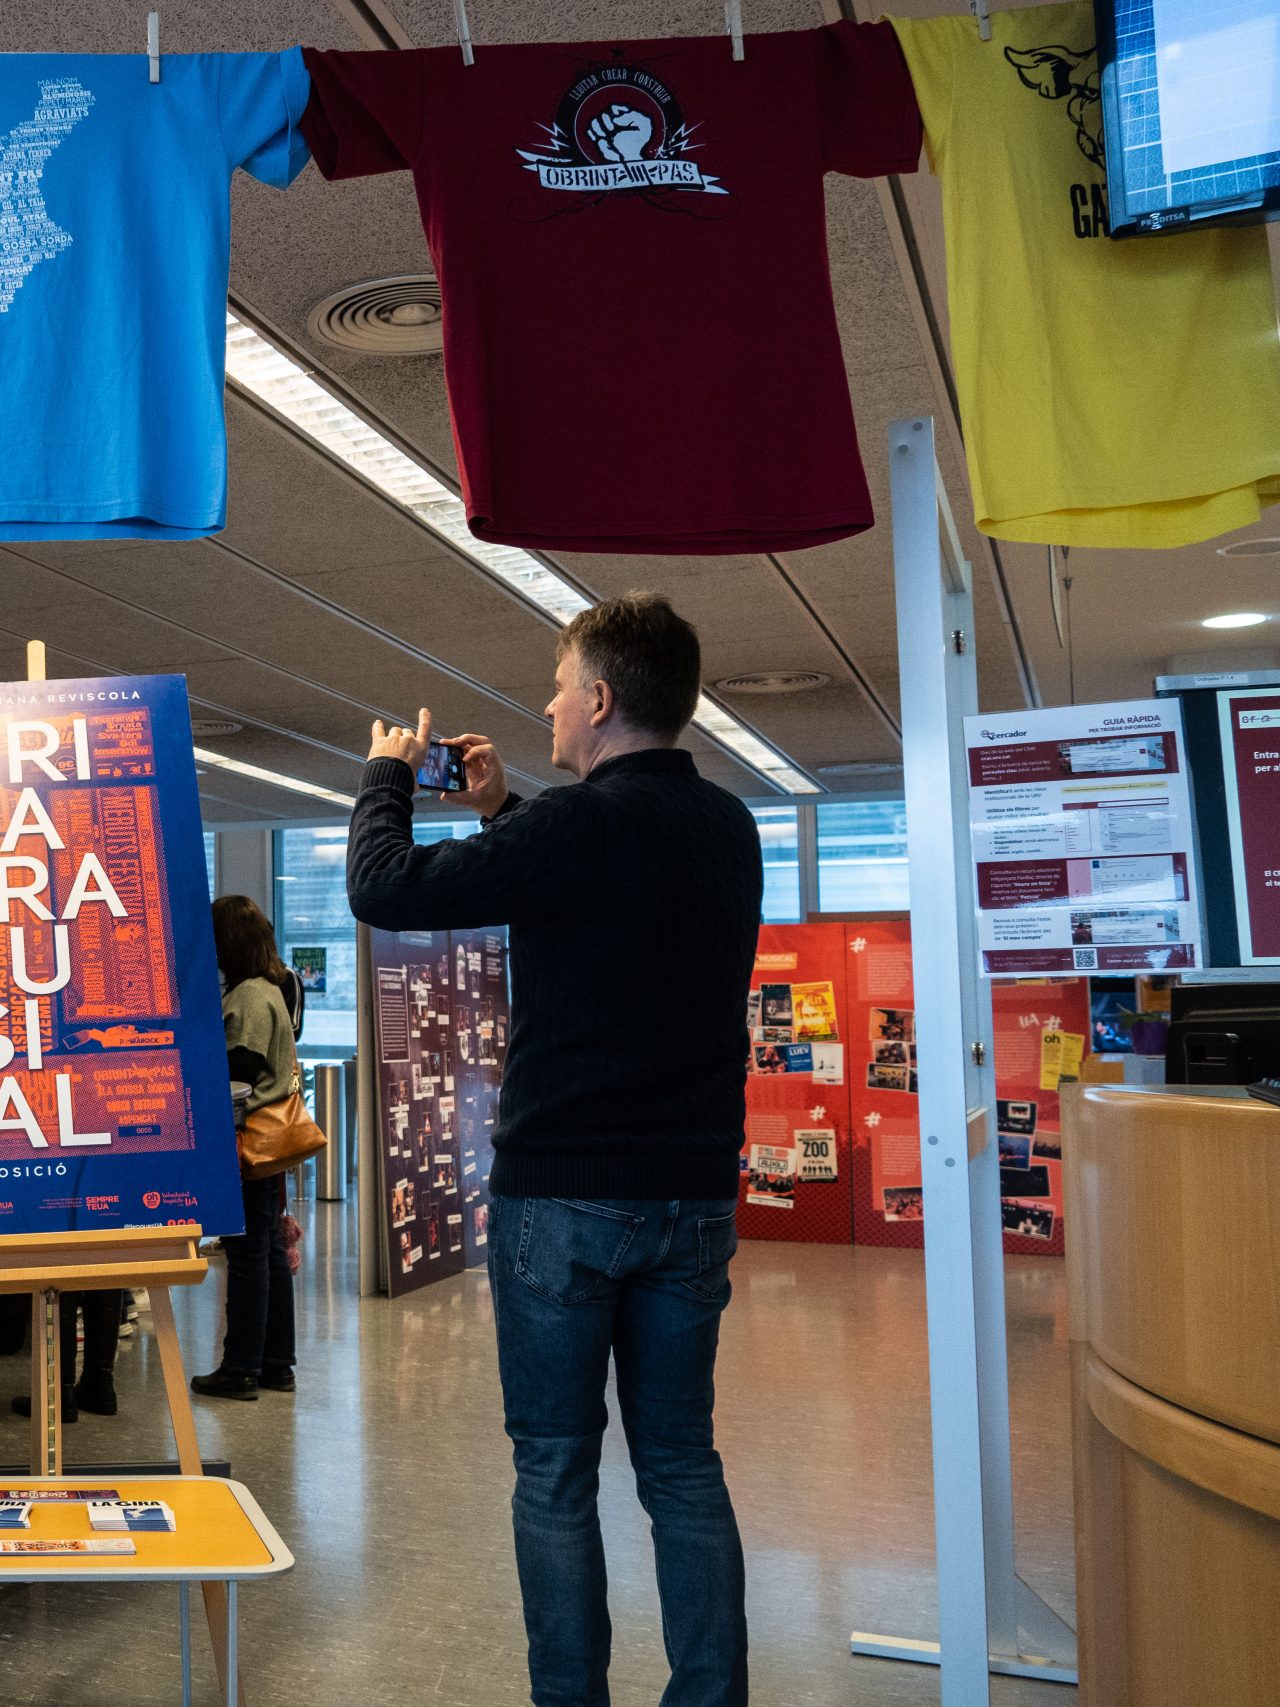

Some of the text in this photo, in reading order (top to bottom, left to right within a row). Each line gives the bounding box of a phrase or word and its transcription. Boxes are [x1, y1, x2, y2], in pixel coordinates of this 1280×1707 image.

[38, 77, 78, 87] MALNOM
[569, 68, 671, 104] LLUITAR CREAR CONSTRUIR
[34, 107, 89, 120] AGRAVIATS
[18, 169, 43, 180] PAS
[546, 162, 695, 188] OBRINT PAS
[1070, 183, 1108, 239] GA
[3, 239, 38, 251] GOSSA
[40, 234, 74, 245] SORDA
[48, 690, 141, 703] REVISCOLA
[1127, 714, 1160, 723] RÀPIDA
[991, 729, 1027, 739] cercador
[1253, 751, 1280, 760] Entra
[1255, 763, 1280, 774] per a
[102, 796, 138, 854] MERUTS
[1044, 1034, 1060, 1044] oh
[802, 1141, 829, 1158] ZOO
[85, 1195, 119, 1204] SEMPRE
[86, 1203, 109, 1211] TEUA
